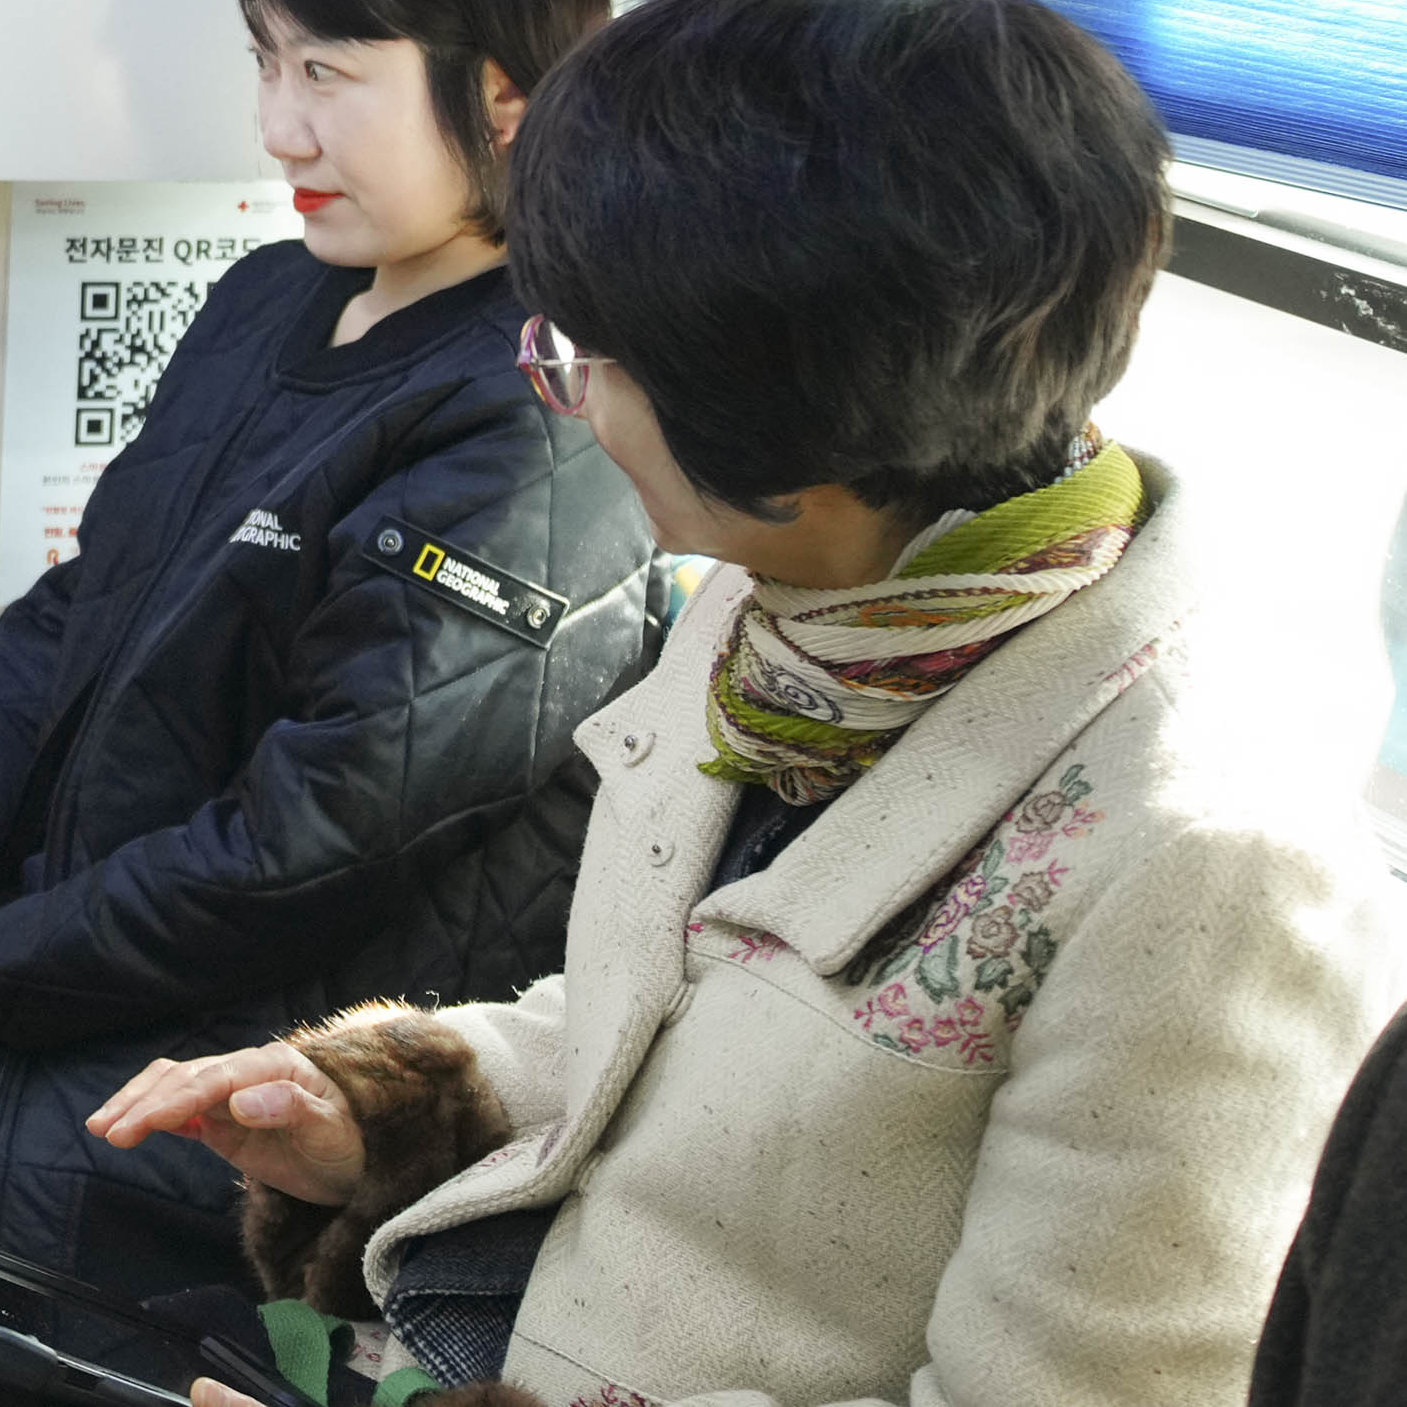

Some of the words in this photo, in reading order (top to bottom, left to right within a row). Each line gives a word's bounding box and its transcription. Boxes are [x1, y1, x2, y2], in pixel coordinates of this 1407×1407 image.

[66, 236, 164, 265] 전자문진
[437, 573, 510, 616] GEOGRAPHIC
[443, 556, 501, 596] NATIONAL
